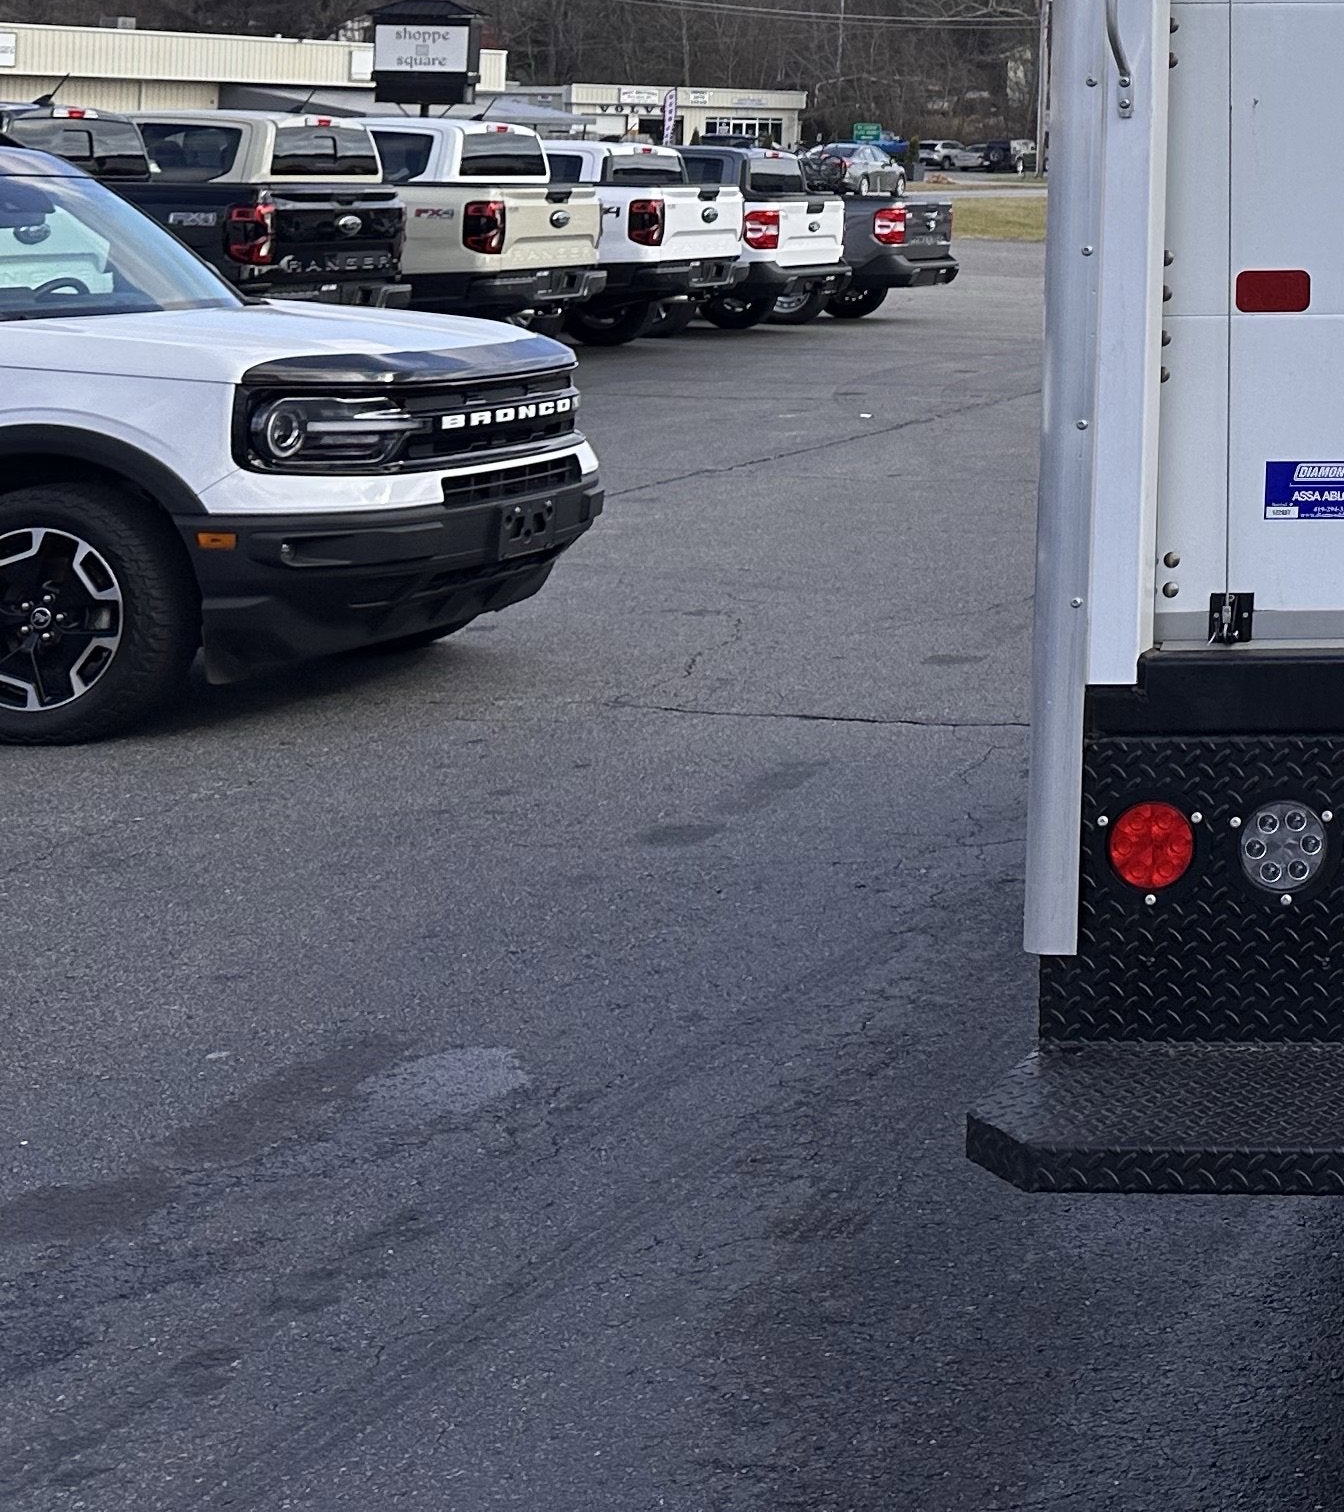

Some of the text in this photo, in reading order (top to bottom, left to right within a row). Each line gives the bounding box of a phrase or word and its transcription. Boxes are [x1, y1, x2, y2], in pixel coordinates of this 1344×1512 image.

[395, 28, 450, 43] shoppe
[396, 56, 447, 68] square
[286, 255, 389, 273] RANGER
[441, 397, 571, 430] BRONCO
[1292, 491, 1321, 501] ASSA
